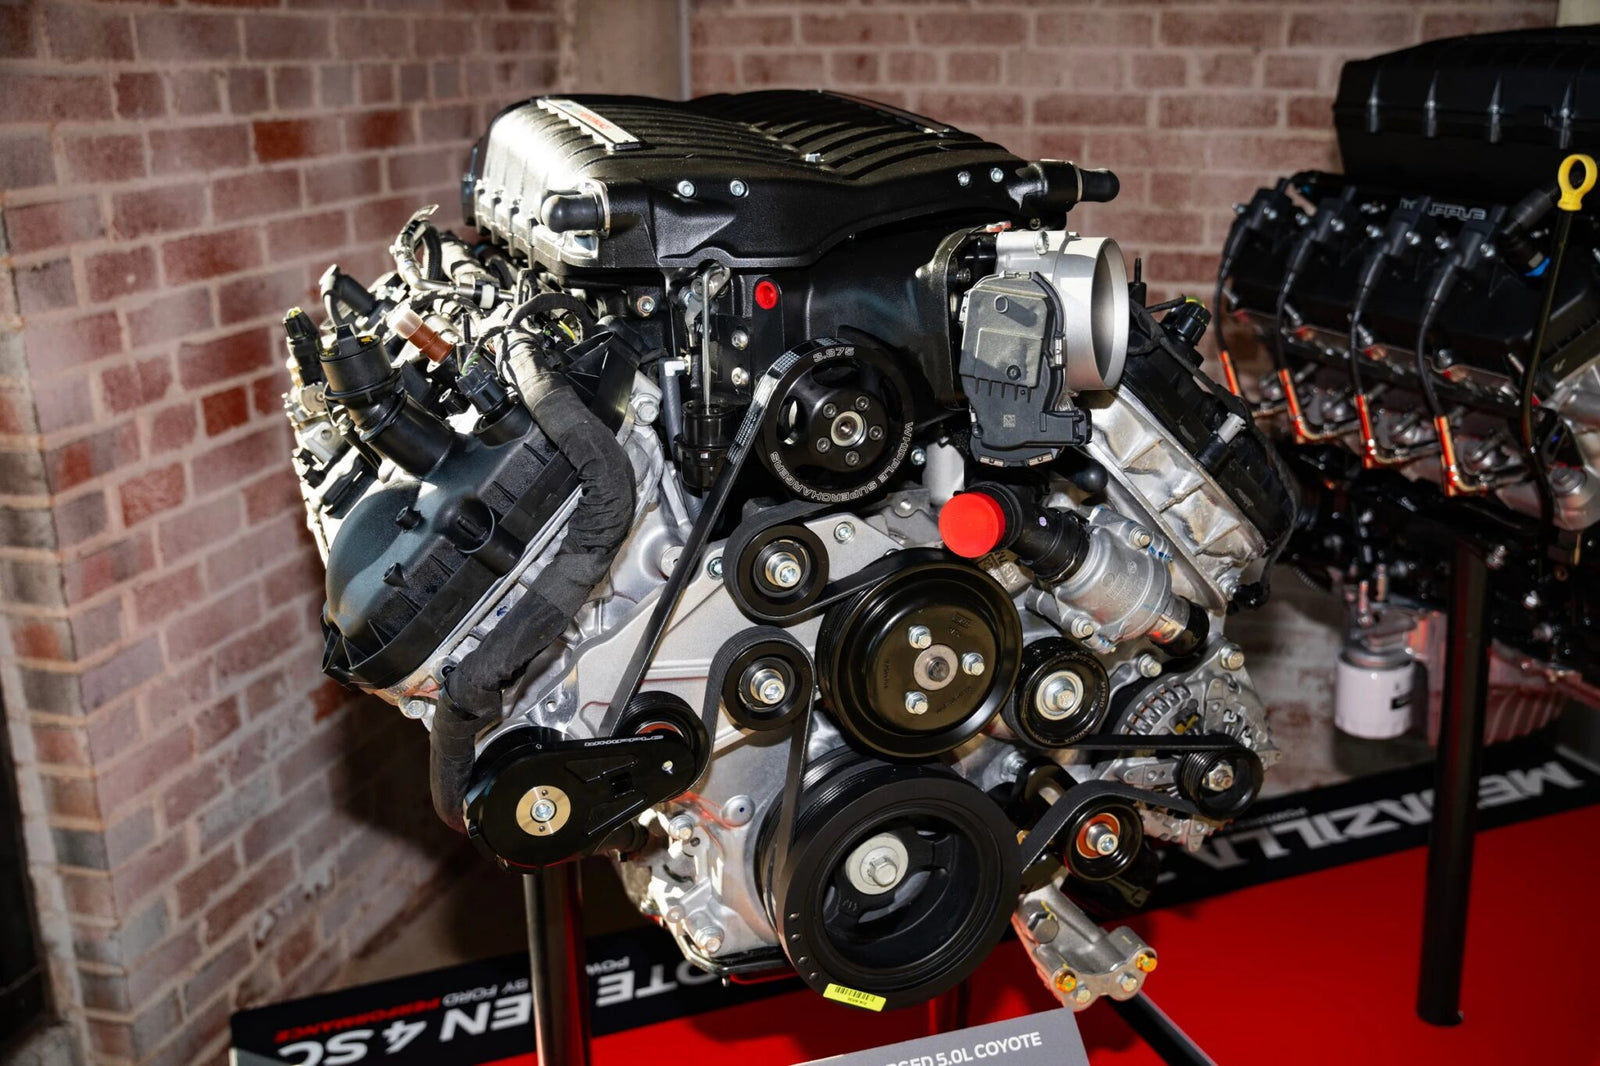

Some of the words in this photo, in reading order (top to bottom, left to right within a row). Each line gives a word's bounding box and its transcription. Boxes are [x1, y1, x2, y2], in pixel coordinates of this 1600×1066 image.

[877, 421, 914, 484] WHIPPLE
[769, 451, 878, 502] SUPERCHARGERS
[442, 984, 498, 1007] FORD
[501, 978, 528, 995] BY
[273, 996, 440, 1044] PERFORMANCE
[382, 1019, 427, 1054] 4
[439, 992, 532, 1042] EN
[935, 1047, 974, 1066] 5.0L
[974, 1031, 1043, 1059] COYOTE
